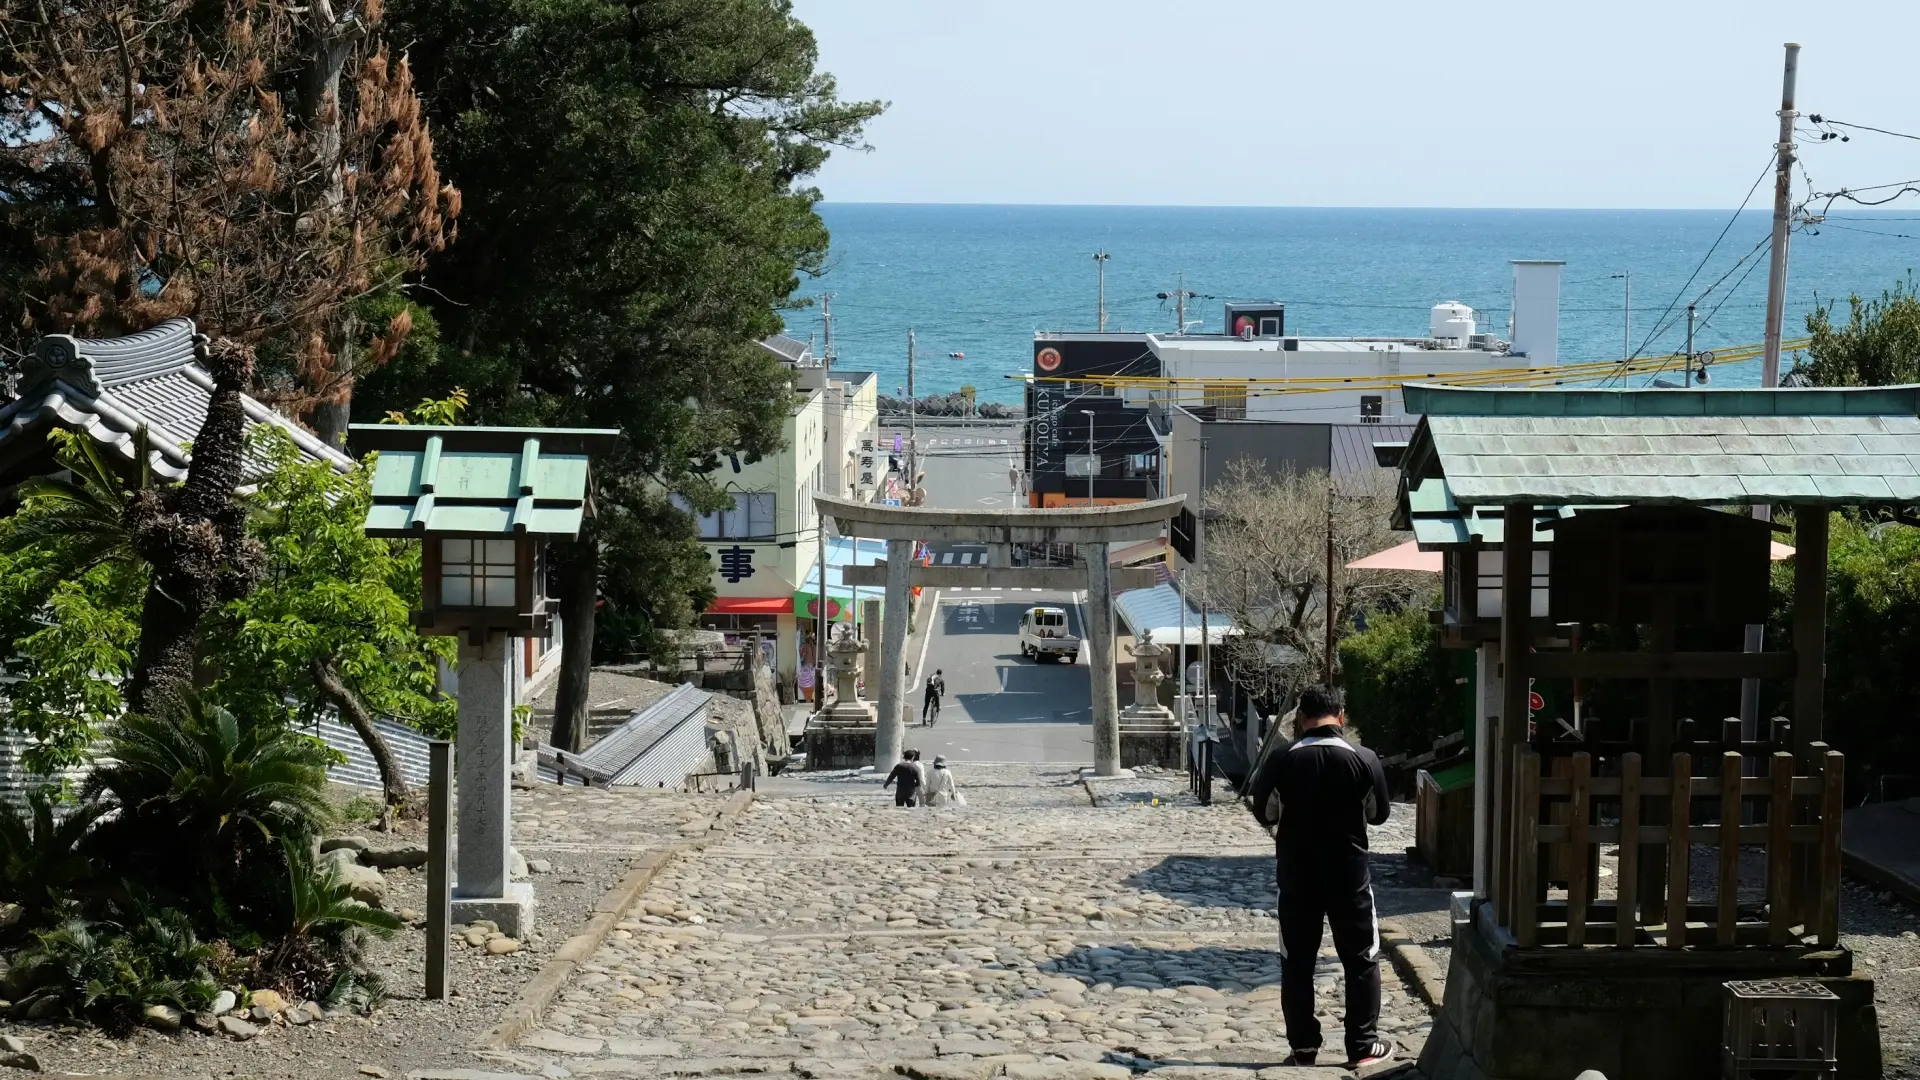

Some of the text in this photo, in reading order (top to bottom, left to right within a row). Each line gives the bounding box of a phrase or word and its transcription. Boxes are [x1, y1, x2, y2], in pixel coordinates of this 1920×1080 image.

[1036, 388, 1050, 467] KUNOUYA
[1050, 399, 1061, 447] ichgo cafe
